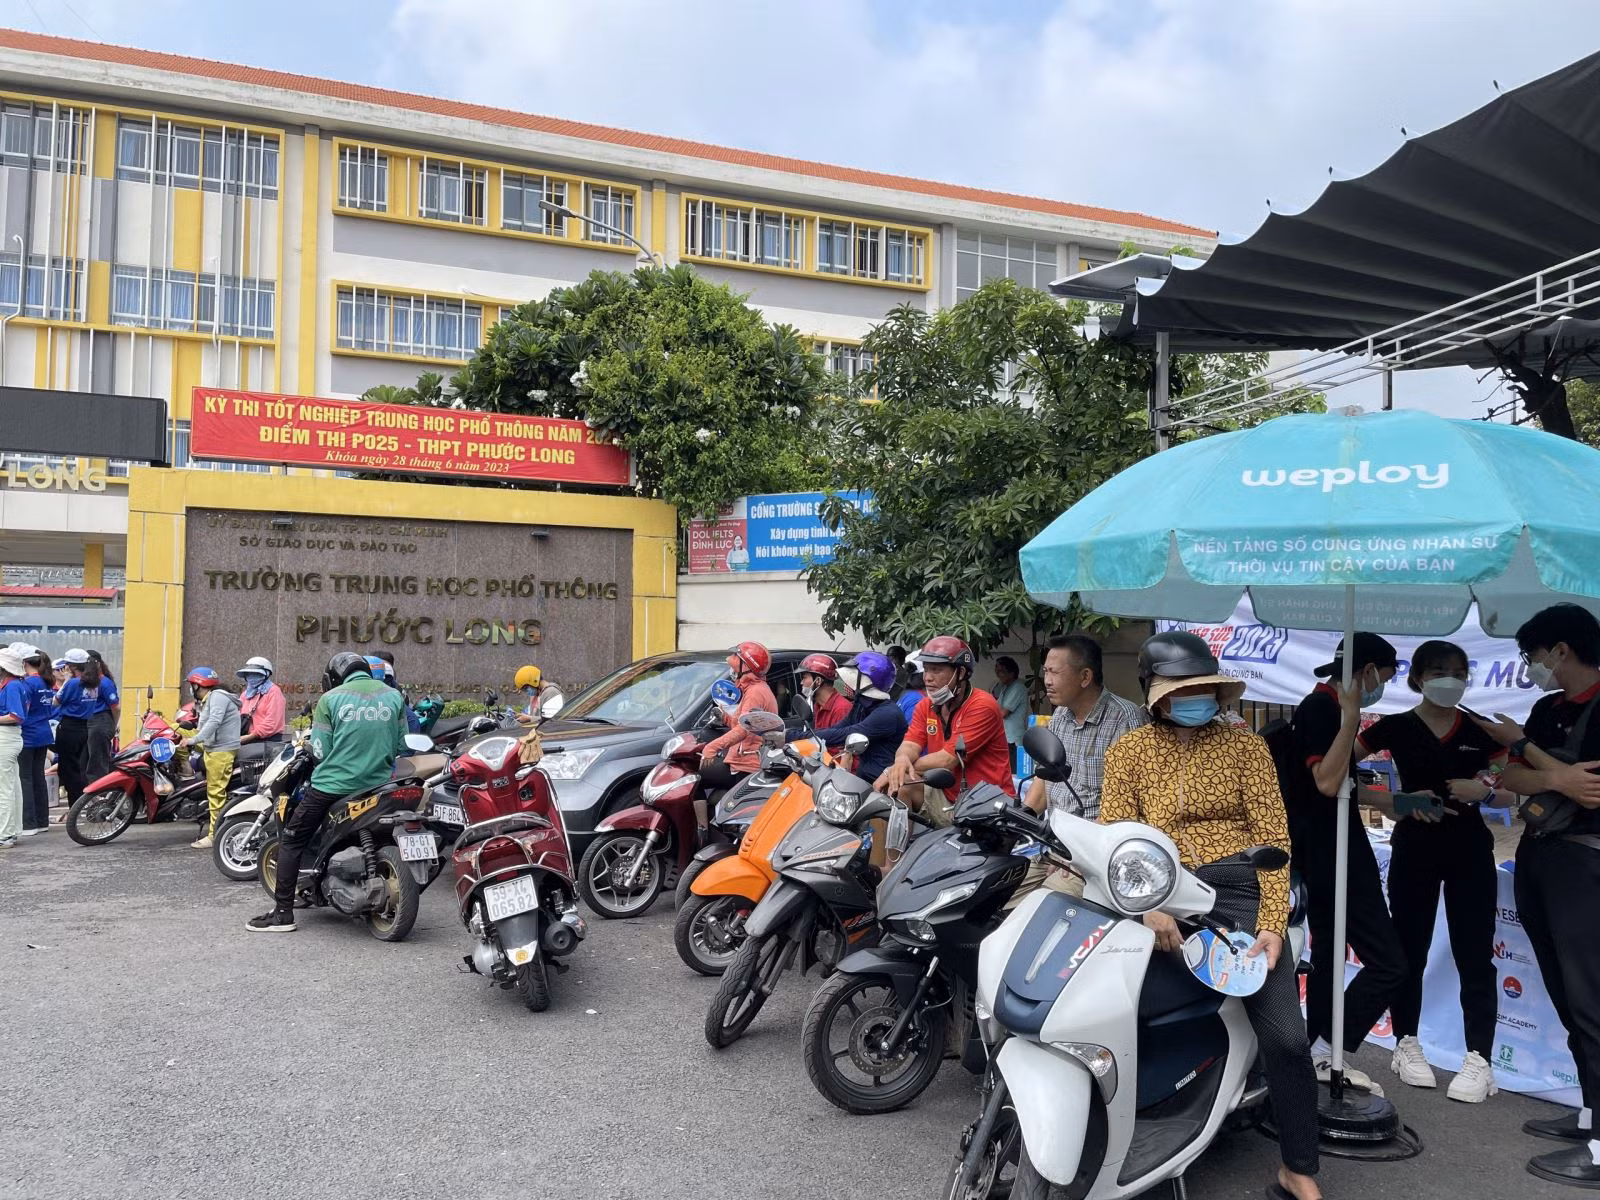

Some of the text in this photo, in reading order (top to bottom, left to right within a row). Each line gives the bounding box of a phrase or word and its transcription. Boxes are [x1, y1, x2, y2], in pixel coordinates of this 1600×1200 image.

[205, 395, 614, 446] KỲ THI TỐT NGHIỆP TRUNG HỌC PHỔ THÔNG NĂM 202
[259, 422, 310, 445] ĐIỂM
[316, 430, 345, 448] THI
[417, 438, 461, 457] THPT
[467, 441, 525, 461] PHƯỚC
[530, 448, 575, 465] LONG
[325, 450, 510, 473] Khóa ngày 28 tháng 6 năm 2023
[8, 463, 106, 491] LONG
[1241, 461, 1449, 493] weploy
[751, 501, 775, 519] CỔNG
[777, 500, 812, 518] TRƯỜNG
[770, 528, 785, 541] Xây
[787, 527, 809, 541] dựng
[1232, 536, 1278, 552] TẢNG
[1283, 534, 1306, 552] SỐ
[1312, 538, 1361, 551] CUNG
[1368, 536, 1406, 551] ỨNG
[1413, 536, 1465, 550] NHÂN
[756, 545, 769, 558] Nói
[771, 545, 798, 559] không
[1227, 554, 1455, 576] THỜI VỤ TIN CẬY CỦA BẠN
[204, 565, 618, 600] TRƯỜNG TRUNG HỌC PHỔ THÔNG
[296, 608, 543, 645] PHƯỚC LONG
[1223, 624, 1288, 660] 2023
[339, 702, 392, 721] Grab
[404, 835, 430, 847] 78-G1
[403, 847, 435, 860] 540.91
[492, 894, 534, 917] 065.82
[1508, 1016, 1537, 1031] ACADEMY
